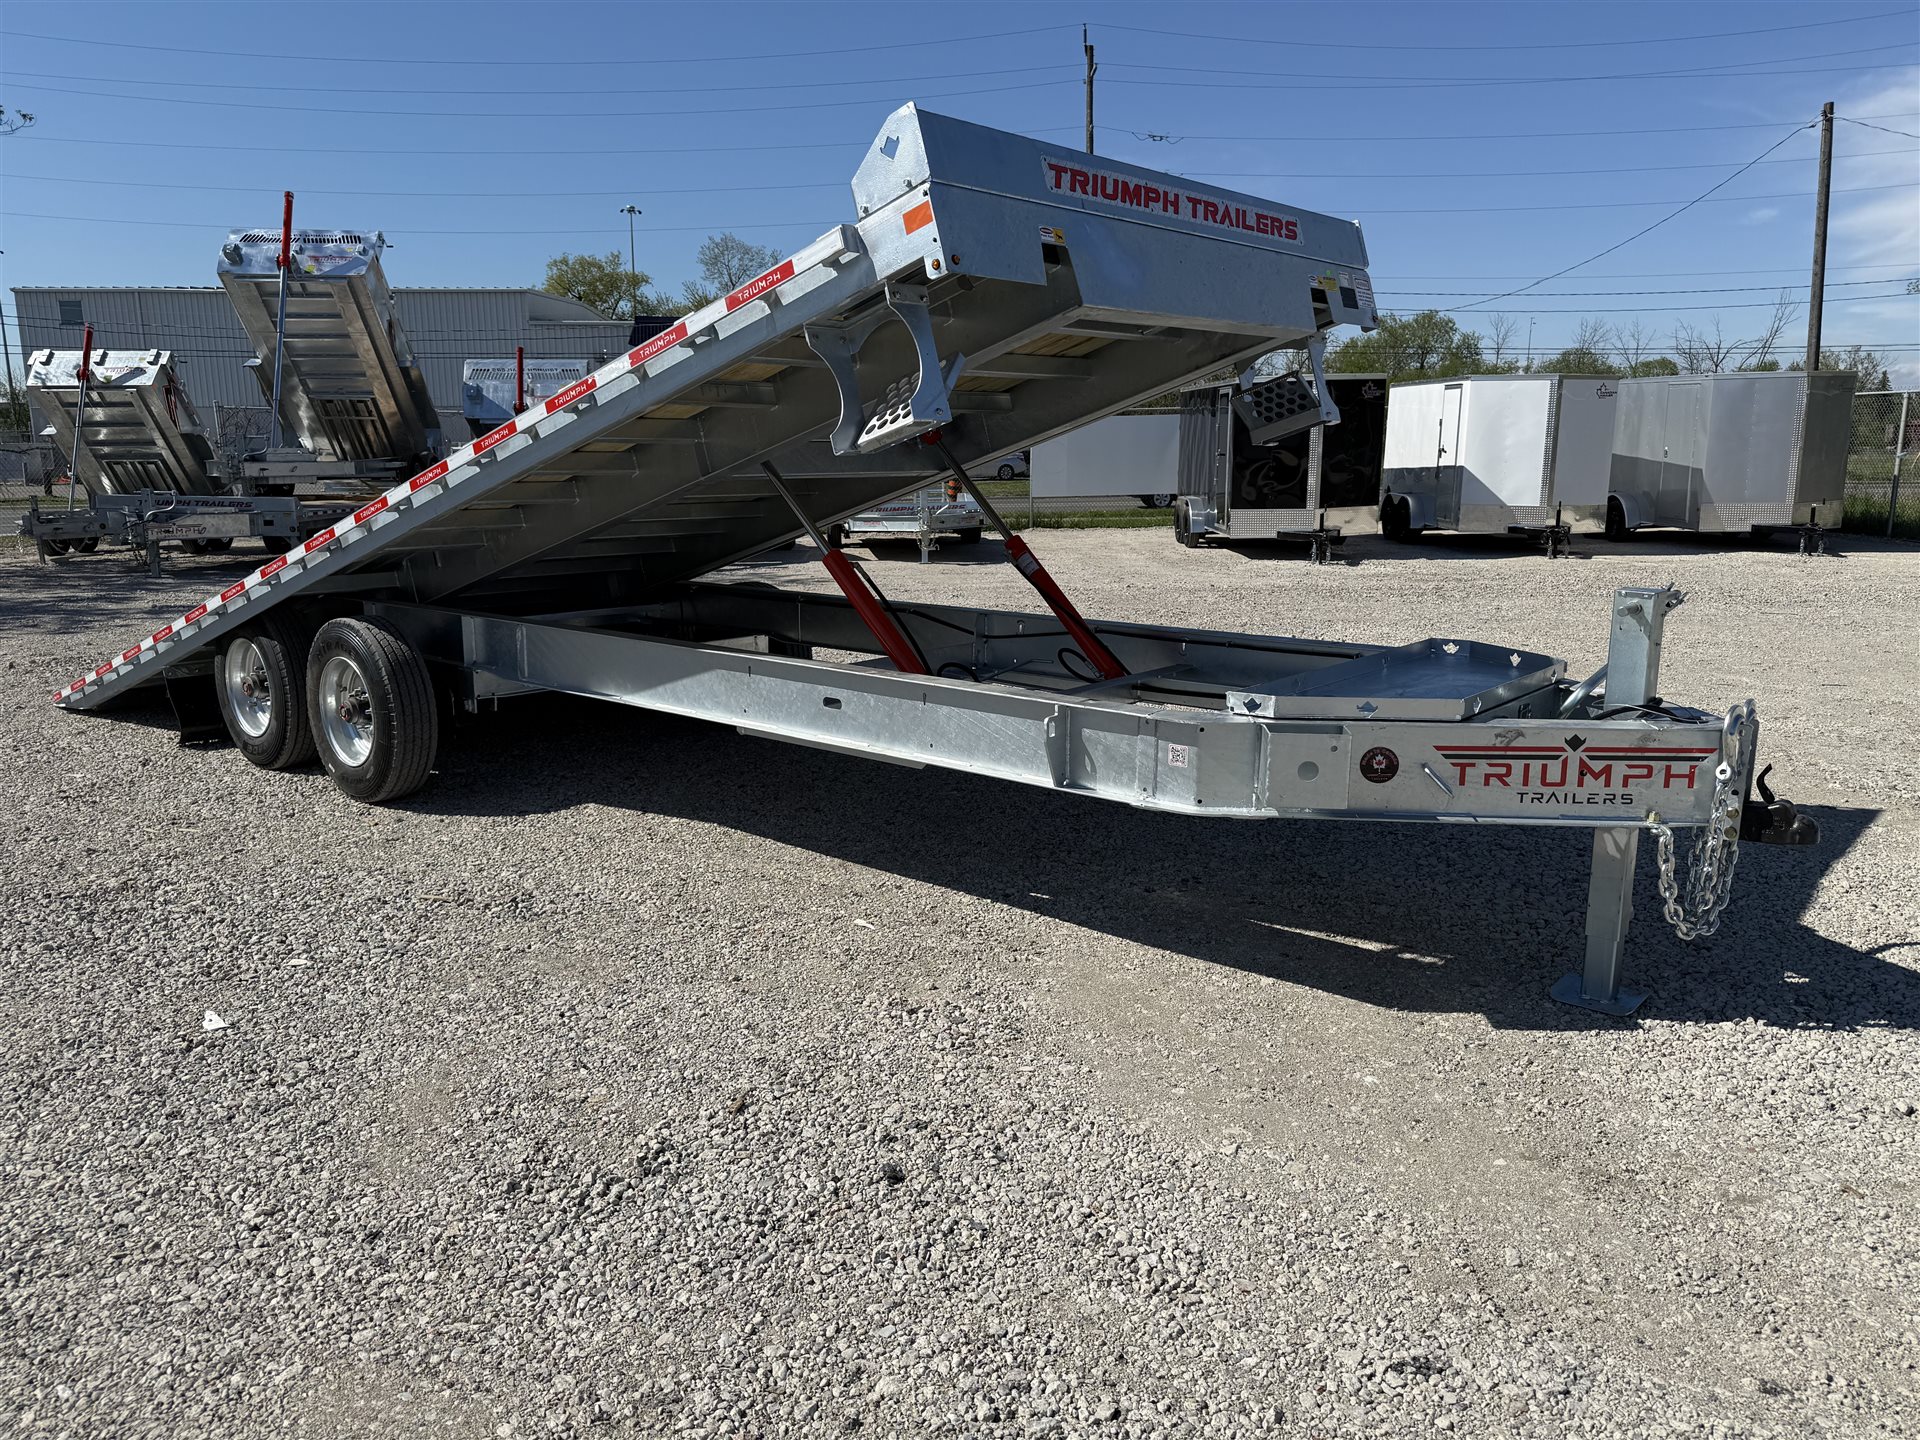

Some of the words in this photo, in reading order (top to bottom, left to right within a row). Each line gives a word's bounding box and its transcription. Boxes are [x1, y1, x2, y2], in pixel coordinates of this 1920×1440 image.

[1047, 162, 1180, 215] TRIUMPH
[1185, 195, 1298, 241] TRAILERS
[738, 272, 781, 301] TRIUMPH
[639, 332, 676, 359] TRIUMPH
[554, 384, 587, 408] TRIUMPH
[480, 428, 509, 449] TRIUMPH
[416, 467, 442, 486] TRIUMPH
[195, 500, 254, 508] TRAILERS
[359, 502, 382, 519] TRIUMPH
[1450, 754, 1700, 789] TRIUMPH
[1516, 791, 1634, 805] TRAILERS
